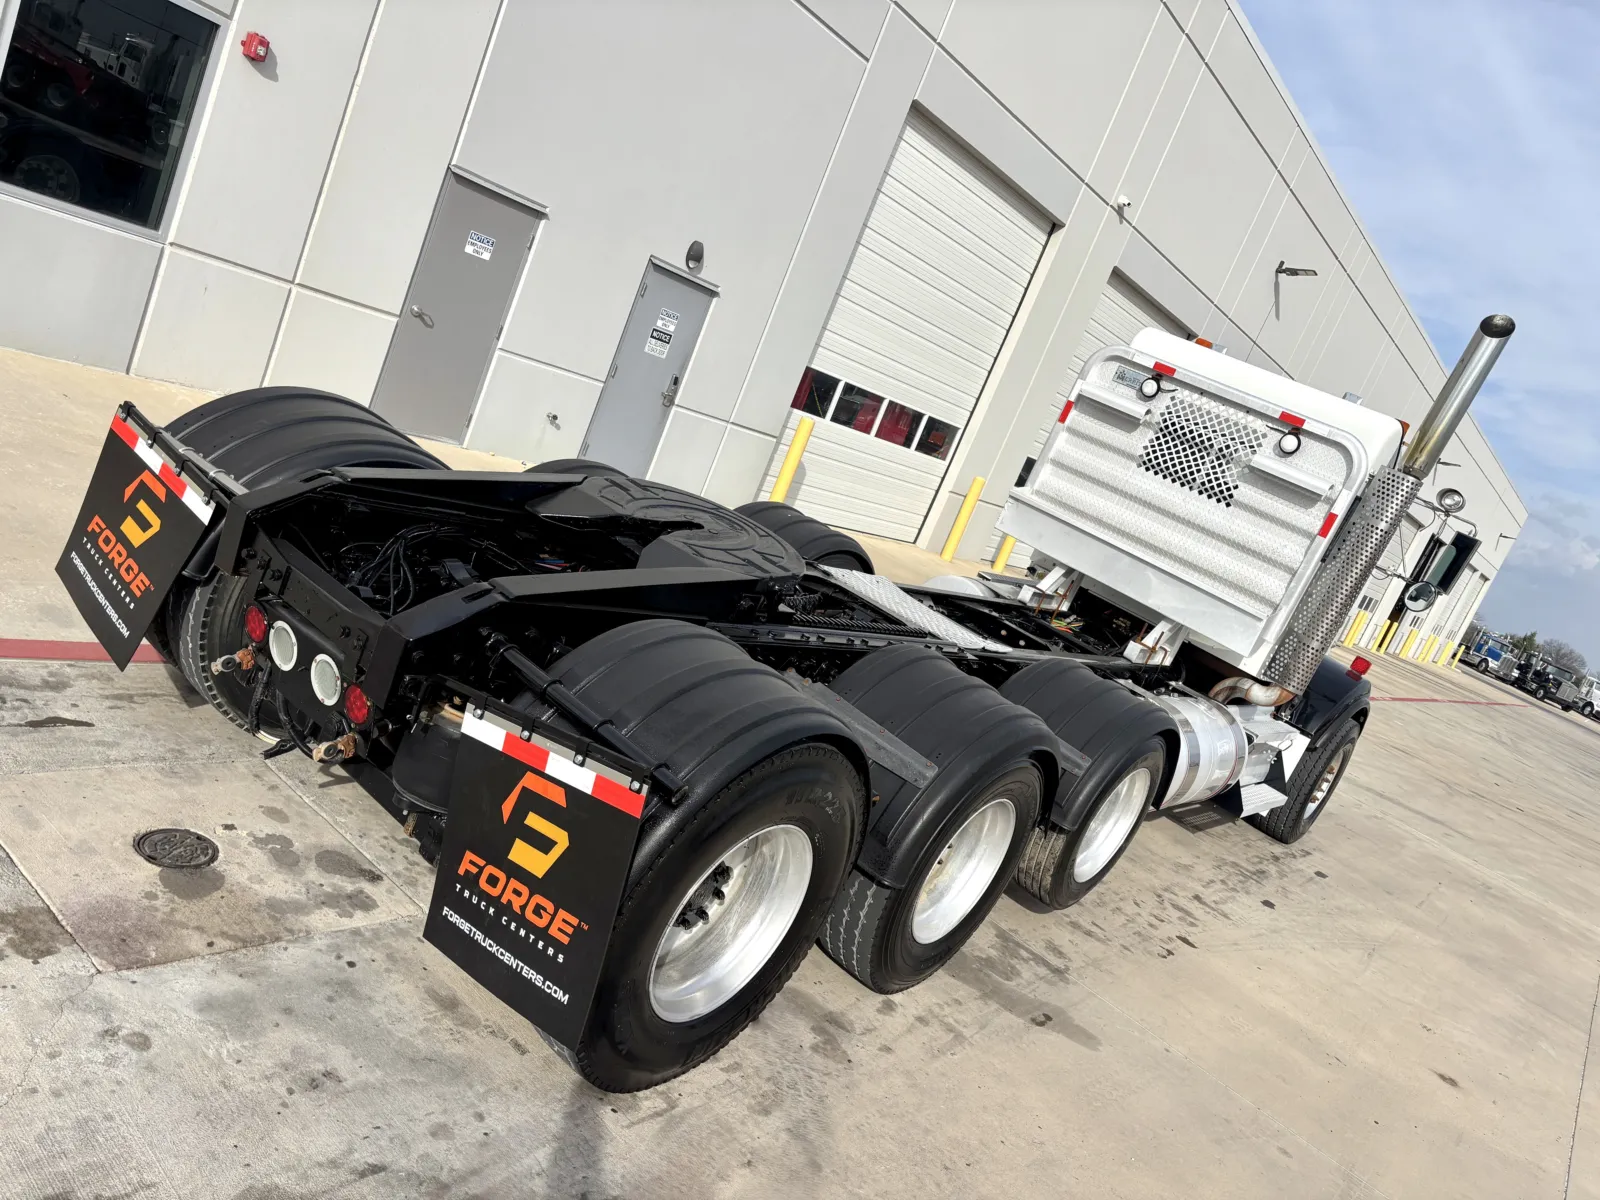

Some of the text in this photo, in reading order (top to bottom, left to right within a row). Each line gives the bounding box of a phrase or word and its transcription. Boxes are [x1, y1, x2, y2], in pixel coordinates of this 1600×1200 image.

[468, 240, 492, 254] EMPLOYEES
[470, 232, 494, 247] NOTICE
[472, 248, 484, 256] ONLY
[652, 330, 670, 343] NOTICE
[82, 536, 135, 610] TRUCK CENTERS
[86, 514, 151, 598] FORGE
[70, 551, 131, 639] FORGETRUCKCENTERS.COM
[455, 883, 565, 964] TRUCK CENTERS
[457, 850, 579, 945] FORGE
[442, 905, 570, 1005] FORGETRUCKCENTERS.COM
